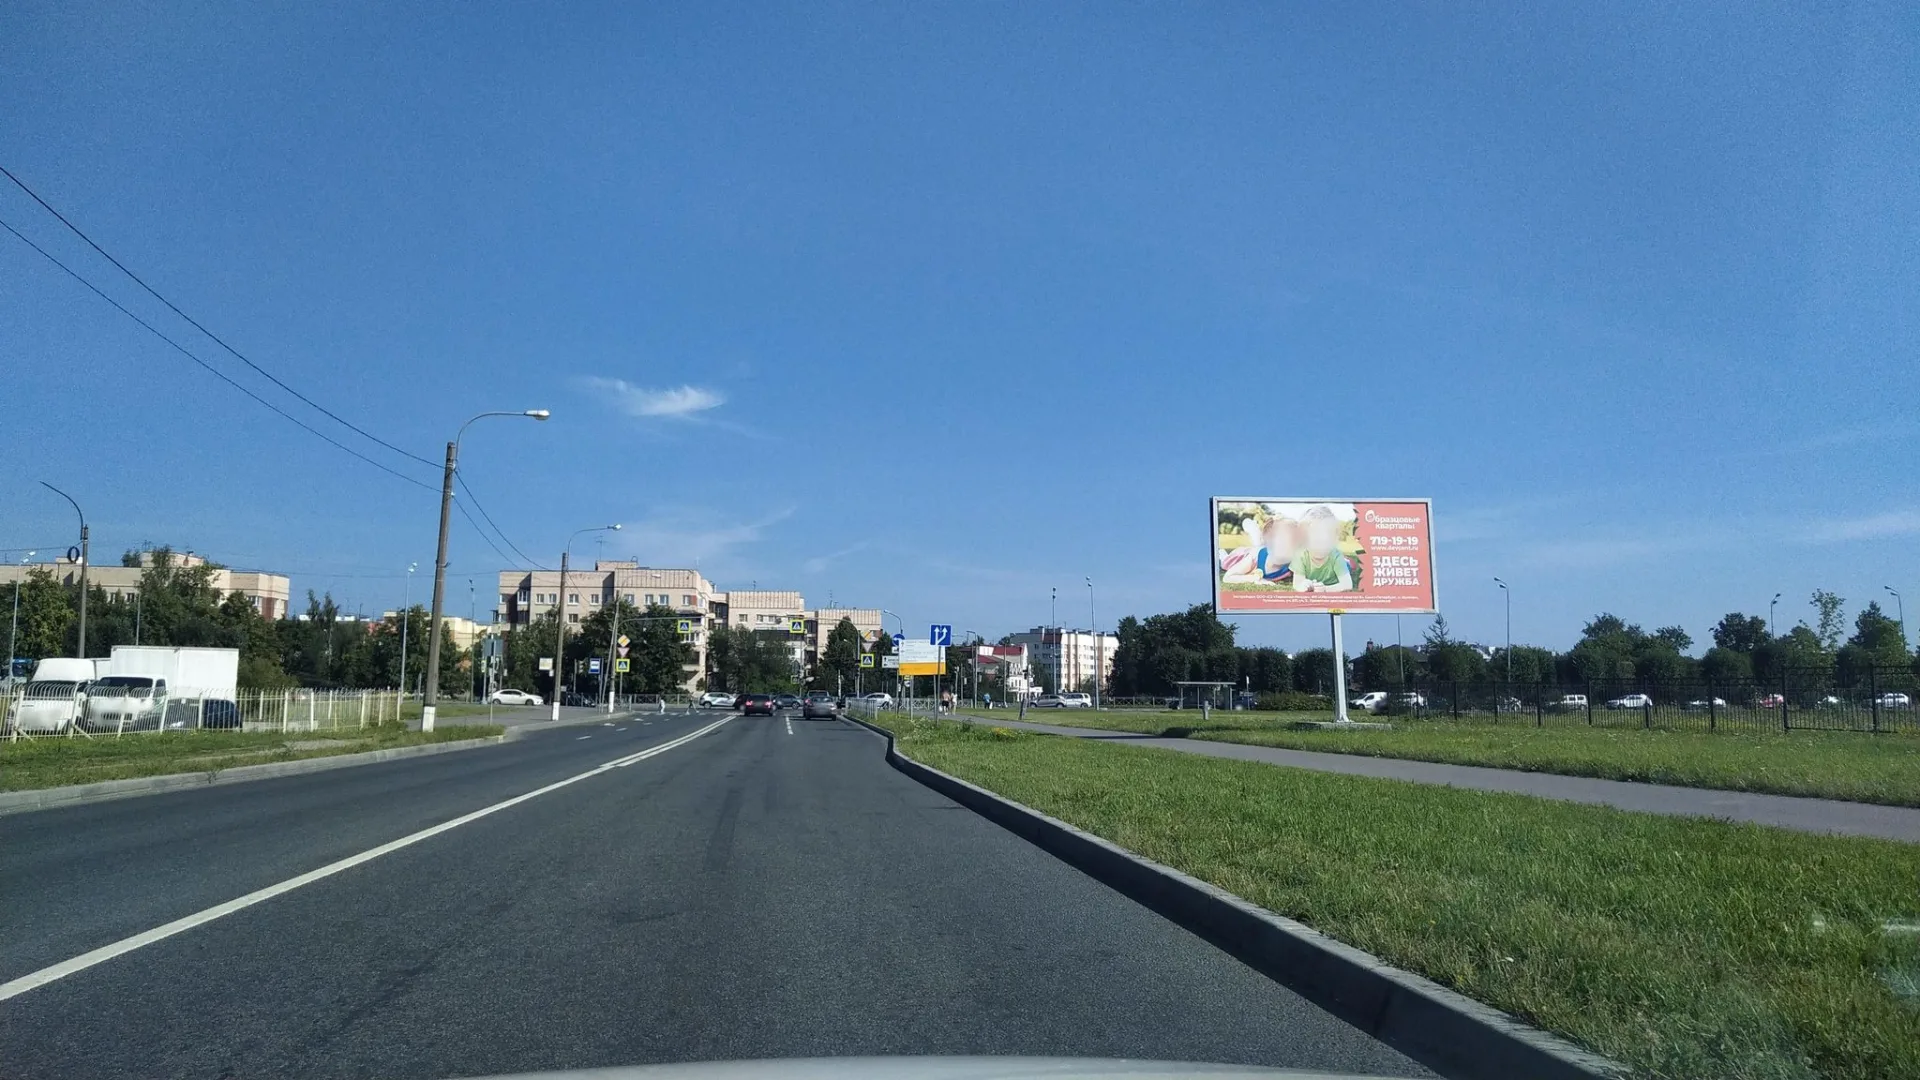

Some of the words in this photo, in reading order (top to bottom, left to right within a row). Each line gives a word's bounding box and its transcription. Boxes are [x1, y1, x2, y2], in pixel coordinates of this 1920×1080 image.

[1365, 510, 1420, 524] Образцовые
[1370, 536, 1419, 545] 719-19-19
[1372, 556, 1419, 568] ЗДЕСЬ
[1373, 567, 1419, 577] ЖИВЕТ
[1373, 577, 1420, 587] ДРУЖБА
